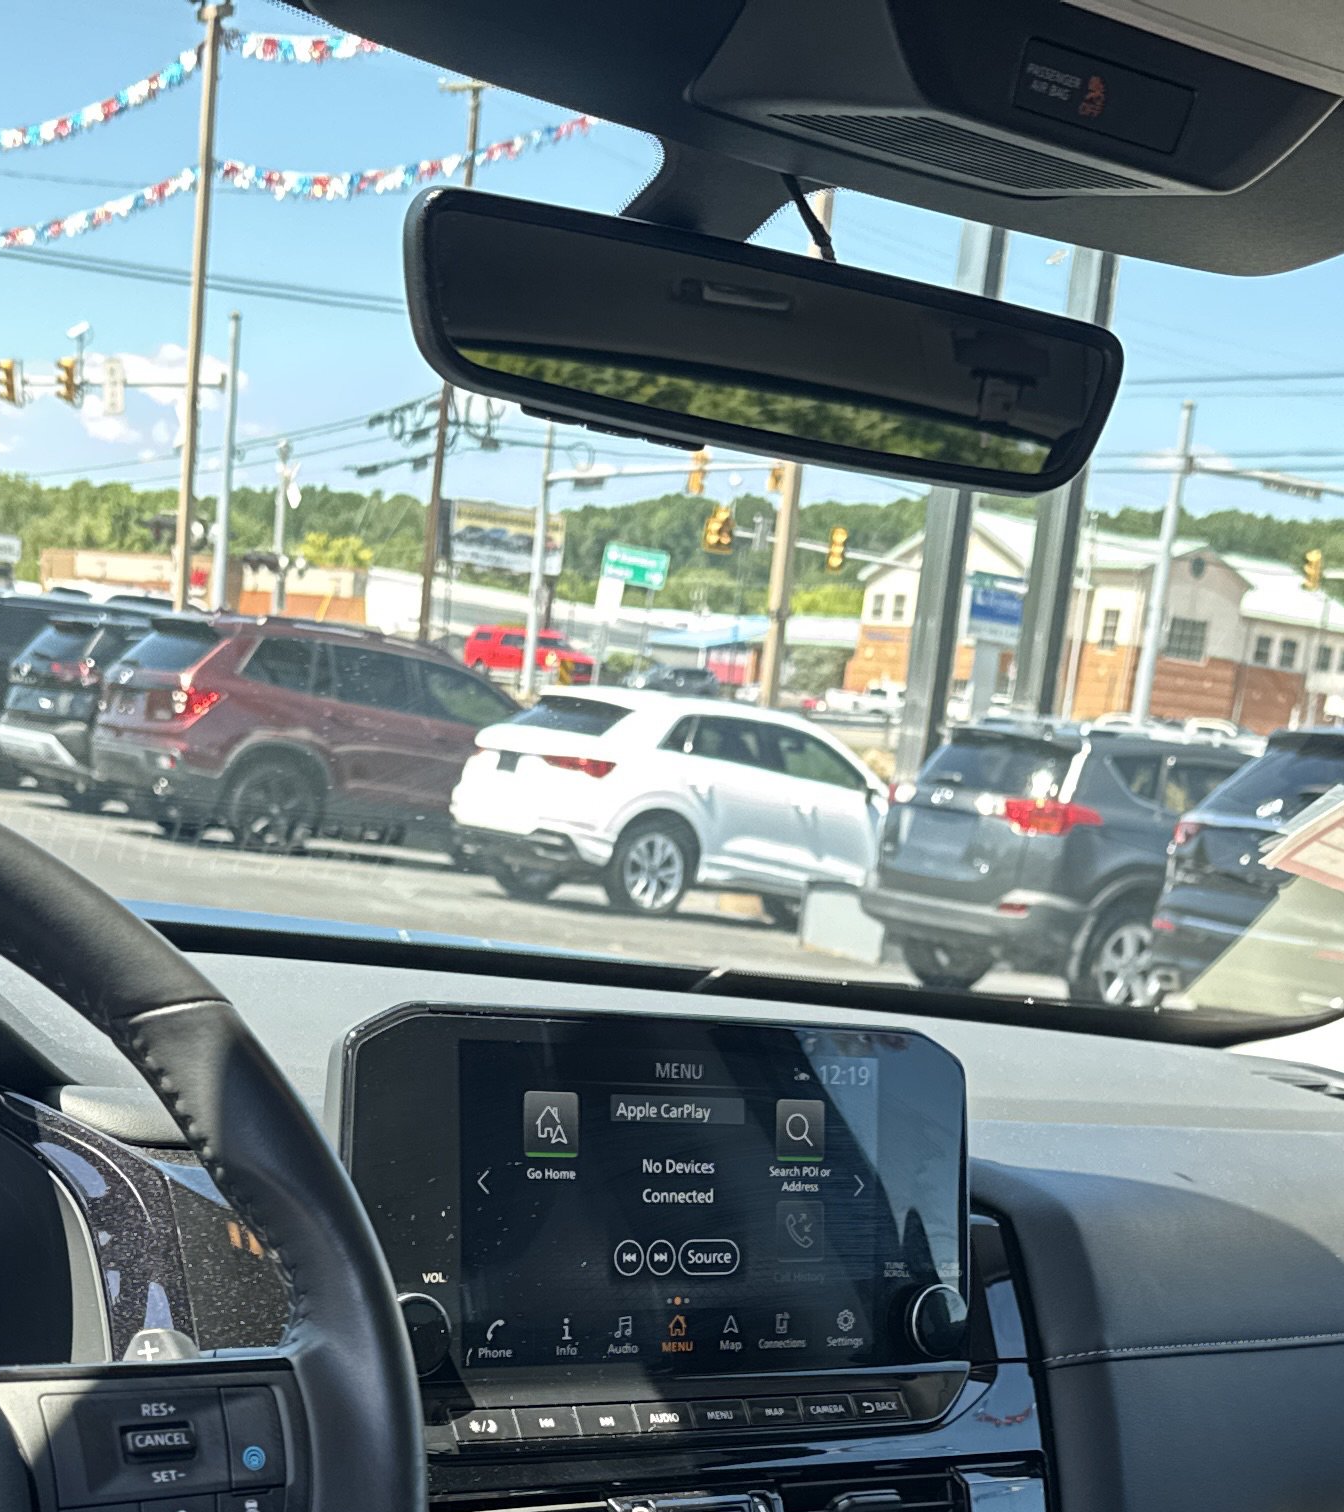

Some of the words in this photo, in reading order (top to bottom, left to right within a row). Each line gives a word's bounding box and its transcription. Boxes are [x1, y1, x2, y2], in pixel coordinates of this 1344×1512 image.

[656, 1062, 703, 1080] MENU
[819, 1064, 870, 1086] 12:19
[615, 1102, 657, 1121] Apple
[660, 1103, 712, 1123] CarPlay
[642, 1159, 662, 1174] No
[665, 1159, 715, 1175] Devices
[768, 1165, 801, 1178] Search
[802, 1166, 818, 1178] POI
[819, 1168, 831, 1178] or
[526, 1168, 543, 1181] Go
[544, 1168, 577, 1181] Home
[781, 1181, 819, 1193] Address
[642, 1188, 715, 1204] Connected
[687, 1250, 732, 1265] Source
[421, 1272, 447, 1284] VOL
[607, 1343, 639, 1355] Audio
[661, 1341, 694, 1353] MENU
[719, 1340, 743, 1353] Map
[758, 1338, 806, 1349] Connections
[826, 1336, 864, 1349] Settings
[477, 1348, 513, 1359] Phone
[556, 1345, 577, 1357] Info
[140, 1402, 177, 1417] RES+
[764, 1407, 785, 1417] MAP
[809, 1404, 845, 1416] CAMERA
[875, 1401, 898, 1412] BACK
[649, 1412, 680, 1425] AUDIO
[706, 1410, 734, 1421] MENU
[134, 1432, 190, 1448] CANCEL
